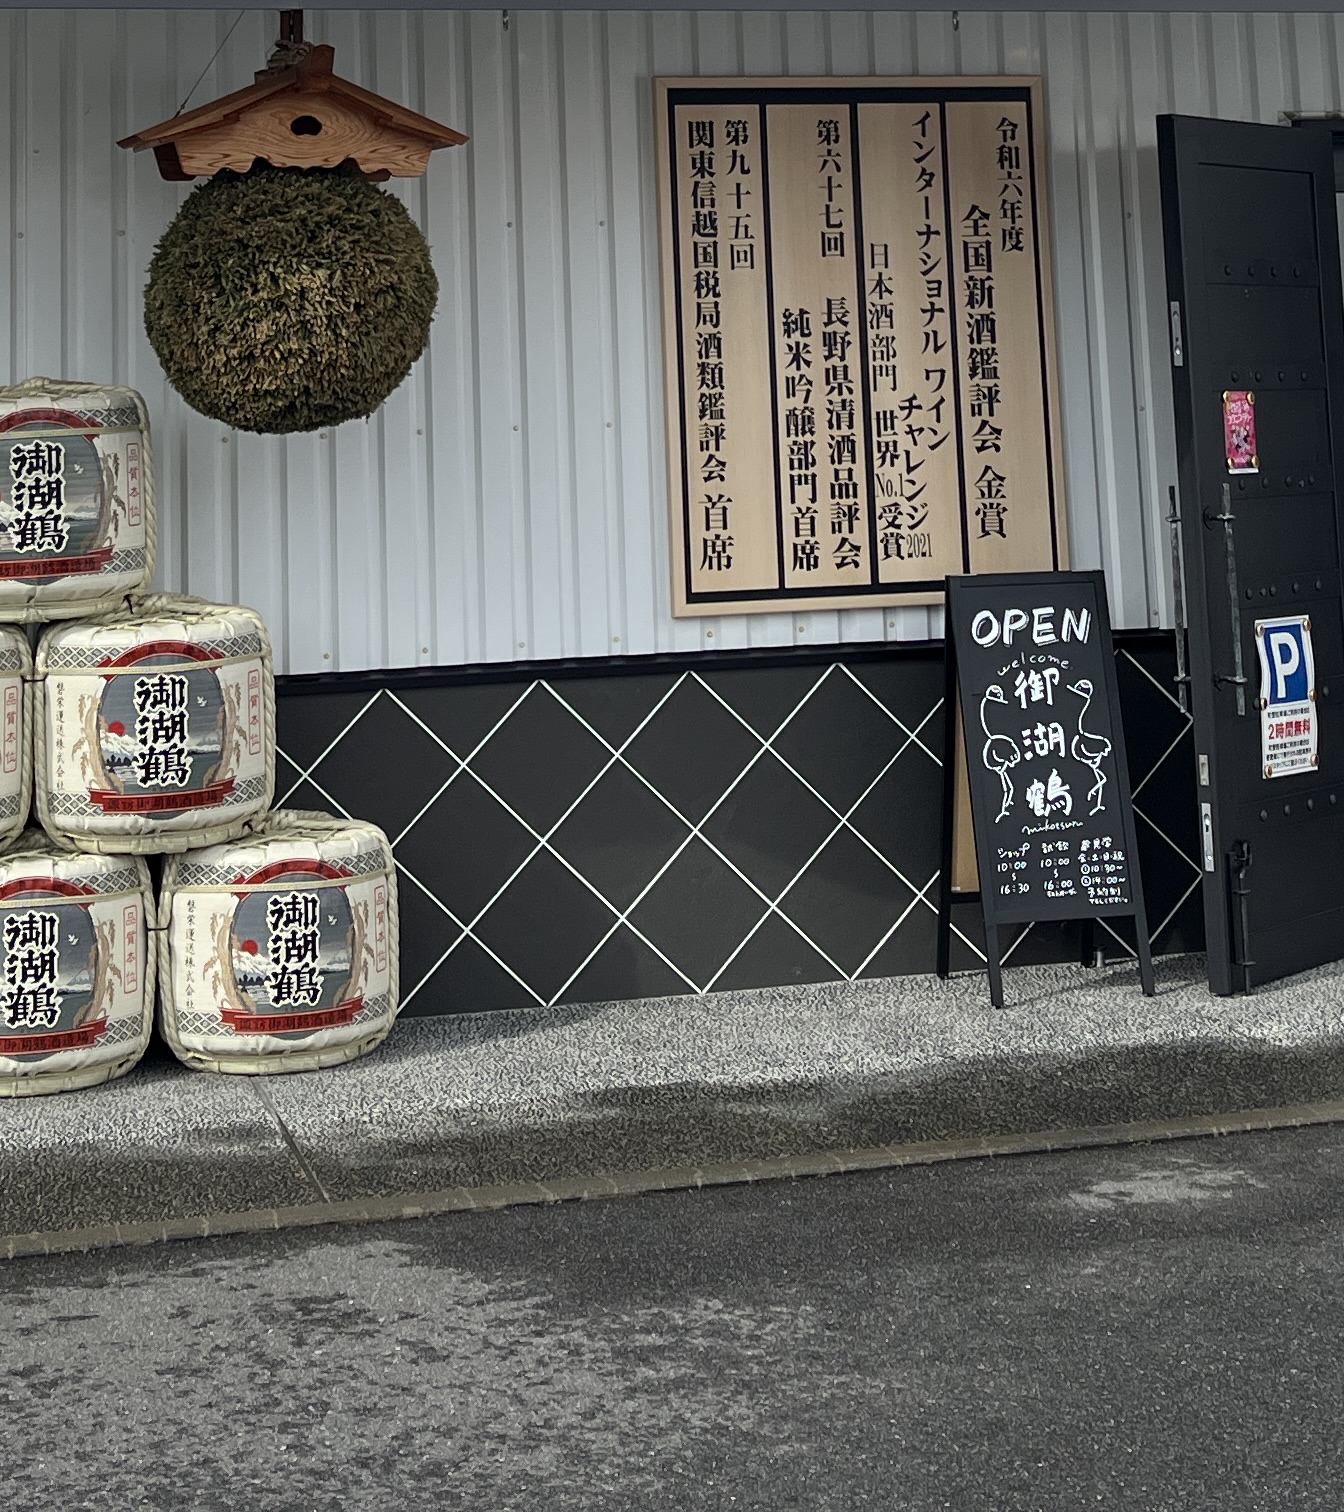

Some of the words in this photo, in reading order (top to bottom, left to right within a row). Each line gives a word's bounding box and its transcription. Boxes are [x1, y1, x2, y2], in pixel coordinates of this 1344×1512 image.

[723, 119, 756, 272] 第九十五回
[815, 119, 846, 258] 第六十七回
[994, 117, 1025, 253] 令和六年度
[911, 110, 949, 356] インターナショナル
[686, 119, 727, 484] 関東信越国税局酒類鑑評会
[867, 242, 898, 393] 日本酒部門
[960, 204, 1003, 454] 全国新酒鑑評会
[781, 308, 820, 572] 純米吟醸部門首席
[821, 297, 861, 571] 長野県清酒品評会
[923, 368, 950, 451] ワイン
[12, 442, 68, 550] 御湖鶴
[699, 493, 734, 572] 首席
[874, 409, 905, 562] 世界No.1受賞
[974, 464, 1008, 539] 金賞
[970, 607, 1092, 649] OPEN
[1269, 631, 1300, 699] P
[5, 692, 16, 765] 品質本位
[136, 675, 189, 785] 御湖鶴
[1014, 667, 1073, 817] 御湖鶴
[1268, 718, 1311, 740] 2時間無料
[997, 842, 1031, 858] ショップ
[997, 861, 1027, 872] 10:00
[1000, 883, 1030, 895] 16:30
[1040, 858, 1070, 868] 10:00
[1041, 841, 1070, 853] 試飲
[1043, 880, 1073, 890] 16:00
[6, 913, 58, 1026] 御湖鶴
[125, 912, 136, 988] 品質本位
[270, 894, 321, 1004] 御湖鶴
[376, 892, 385, 966] 品質本位
